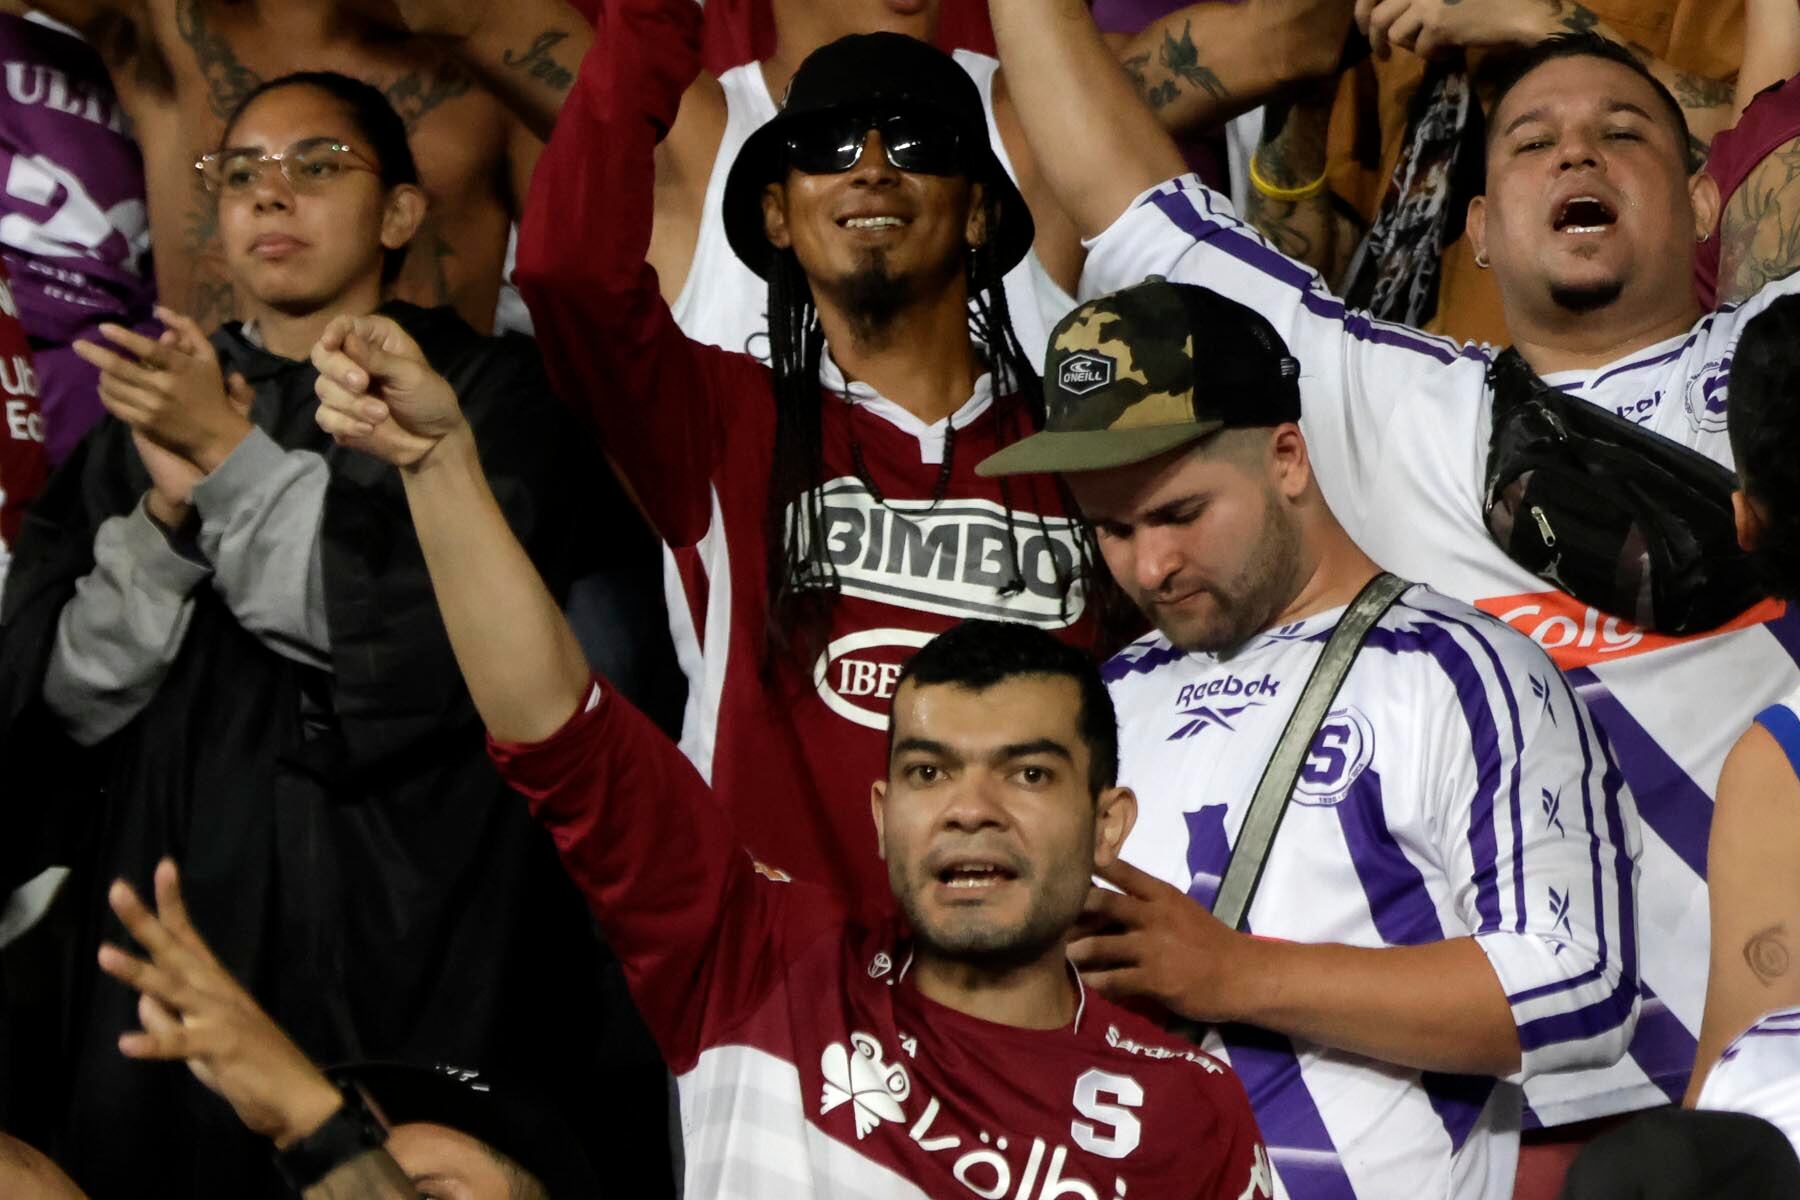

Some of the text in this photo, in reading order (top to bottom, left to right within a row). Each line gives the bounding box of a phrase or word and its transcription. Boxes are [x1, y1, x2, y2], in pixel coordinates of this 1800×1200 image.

[824, 506, 1073, 600] BIMBO
[1176, 673, 1280, 707] Reebok
[1071, 1067, 1144, 1159] S
